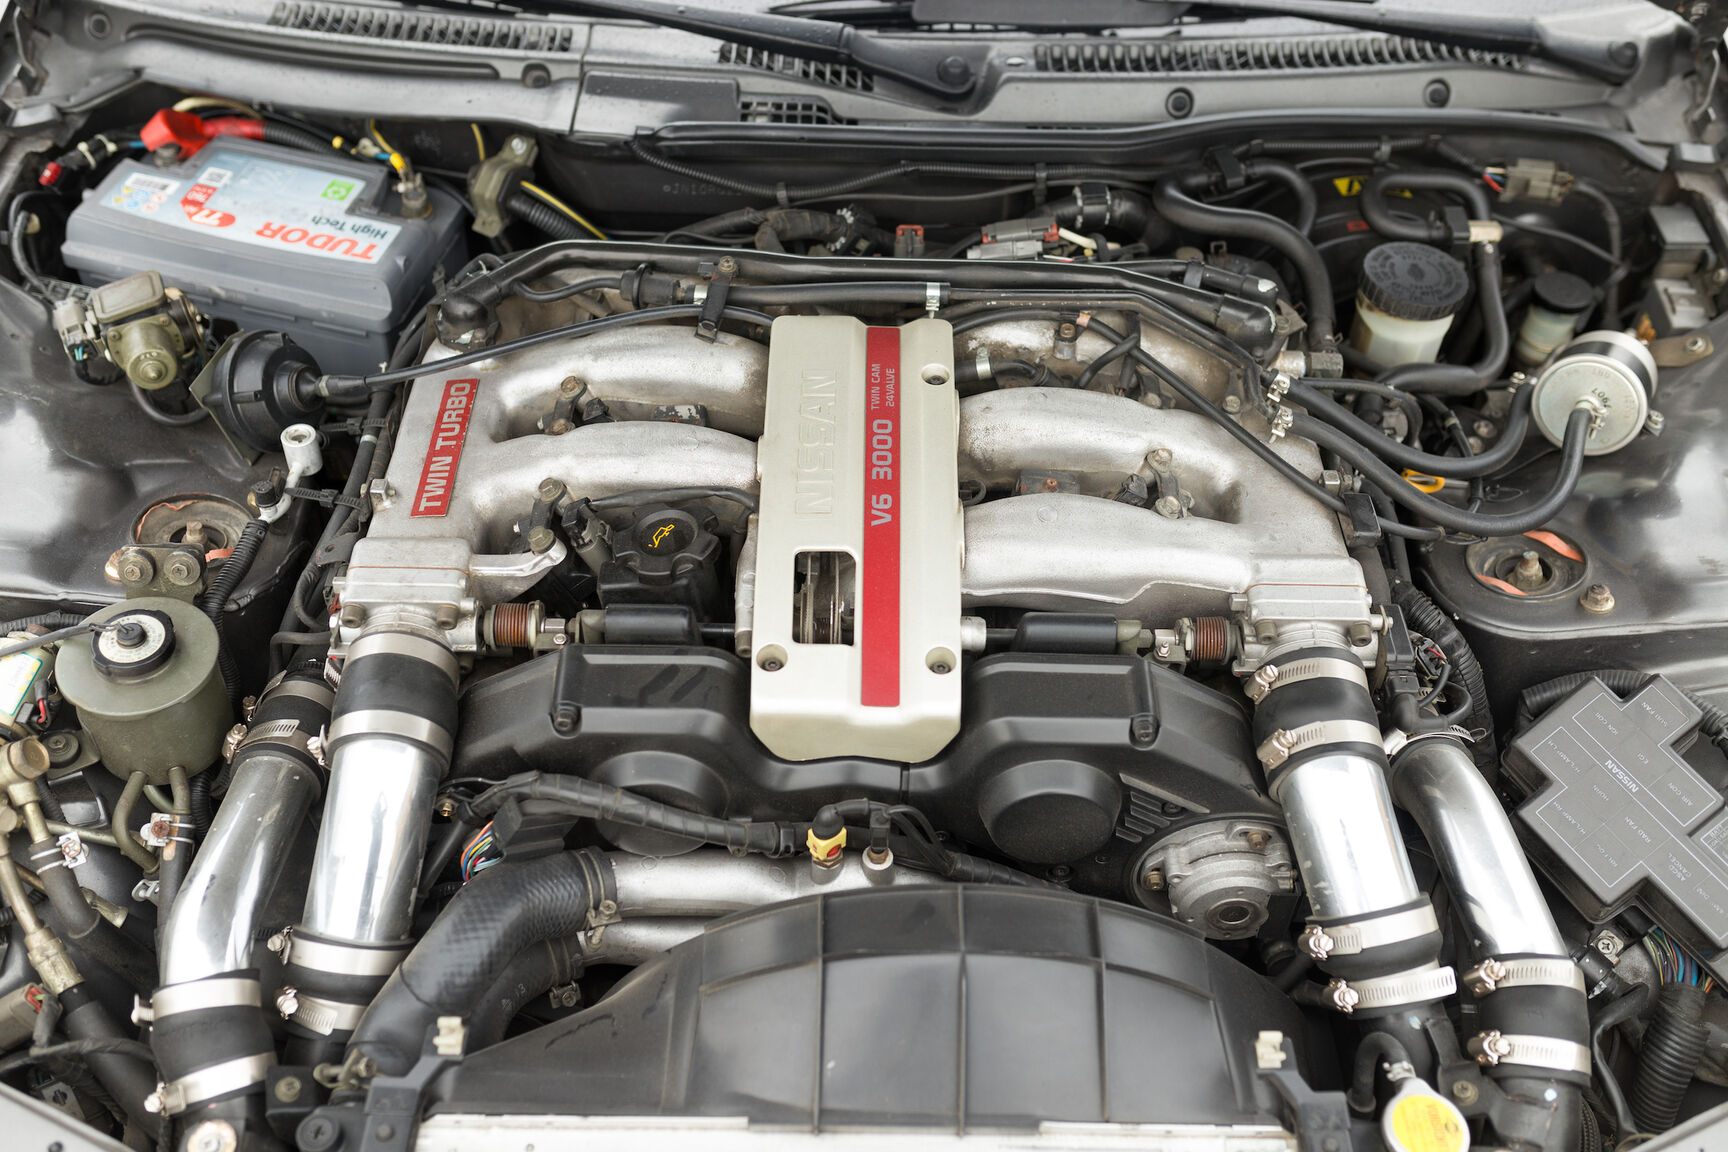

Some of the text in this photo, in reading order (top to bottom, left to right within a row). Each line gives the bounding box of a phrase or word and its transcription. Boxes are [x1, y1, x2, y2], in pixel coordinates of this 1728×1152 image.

[191, 208, 222, 225] 77
[311, 215, 389, 240] High Tech
[255, 221, 379, 260] TUDOR
[871, 364, 881, 411] TWIN CAM
[885, 368, 895, 407] 24VALVE
[418, 382, 471, 512] TWIN TURBO
[795, 368, 836, 515] NISSAN
[871, 419, 893, 527] V6 3000
[1604, 759, 1640, 793] NISSAN
[1624, 815, 1639, 830] FAN
